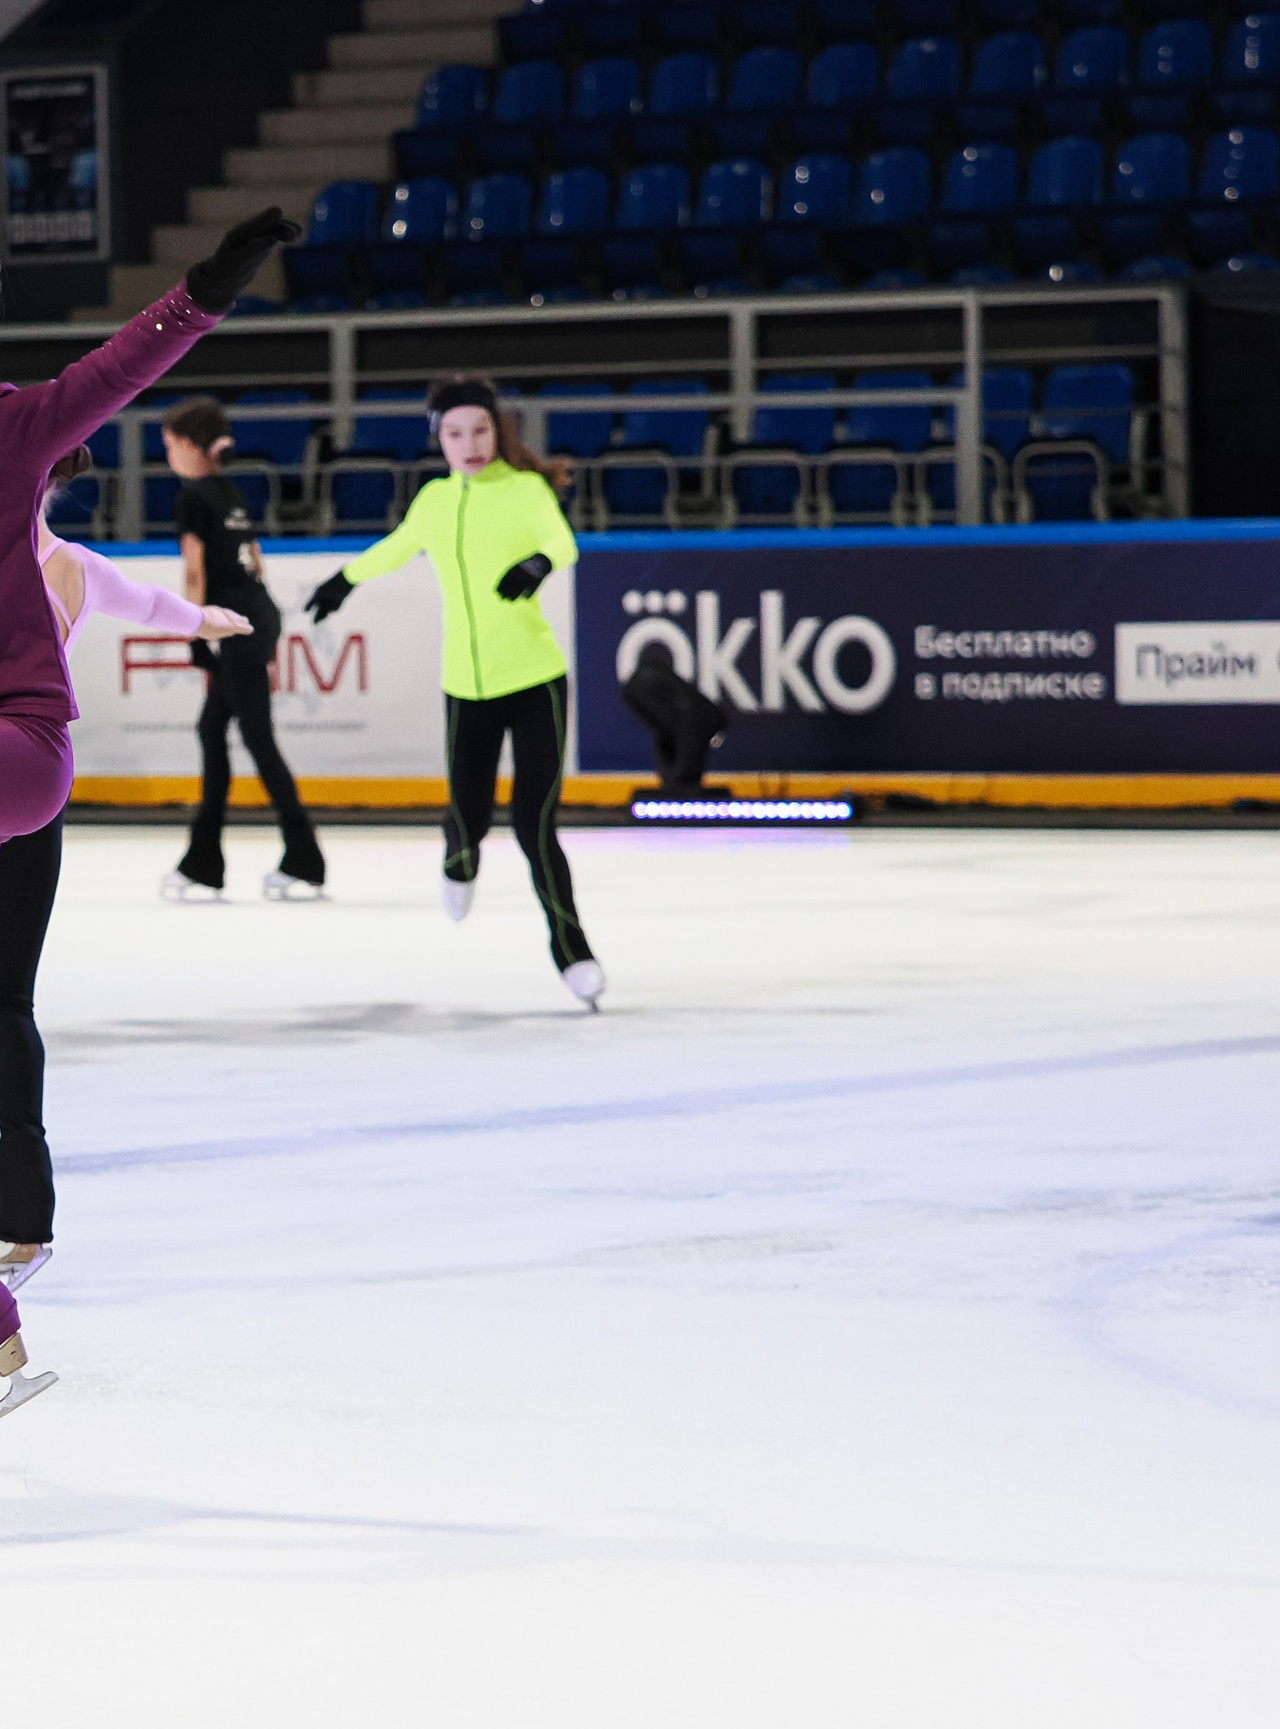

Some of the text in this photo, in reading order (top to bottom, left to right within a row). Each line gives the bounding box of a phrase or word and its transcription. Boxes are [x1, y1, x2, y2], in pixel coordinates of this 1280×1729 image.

[915, 624, 1097, 660] Бесплатно
[1136, 644, 1258, 688] Прайм
[941, 672, 1107, 704] подписке
